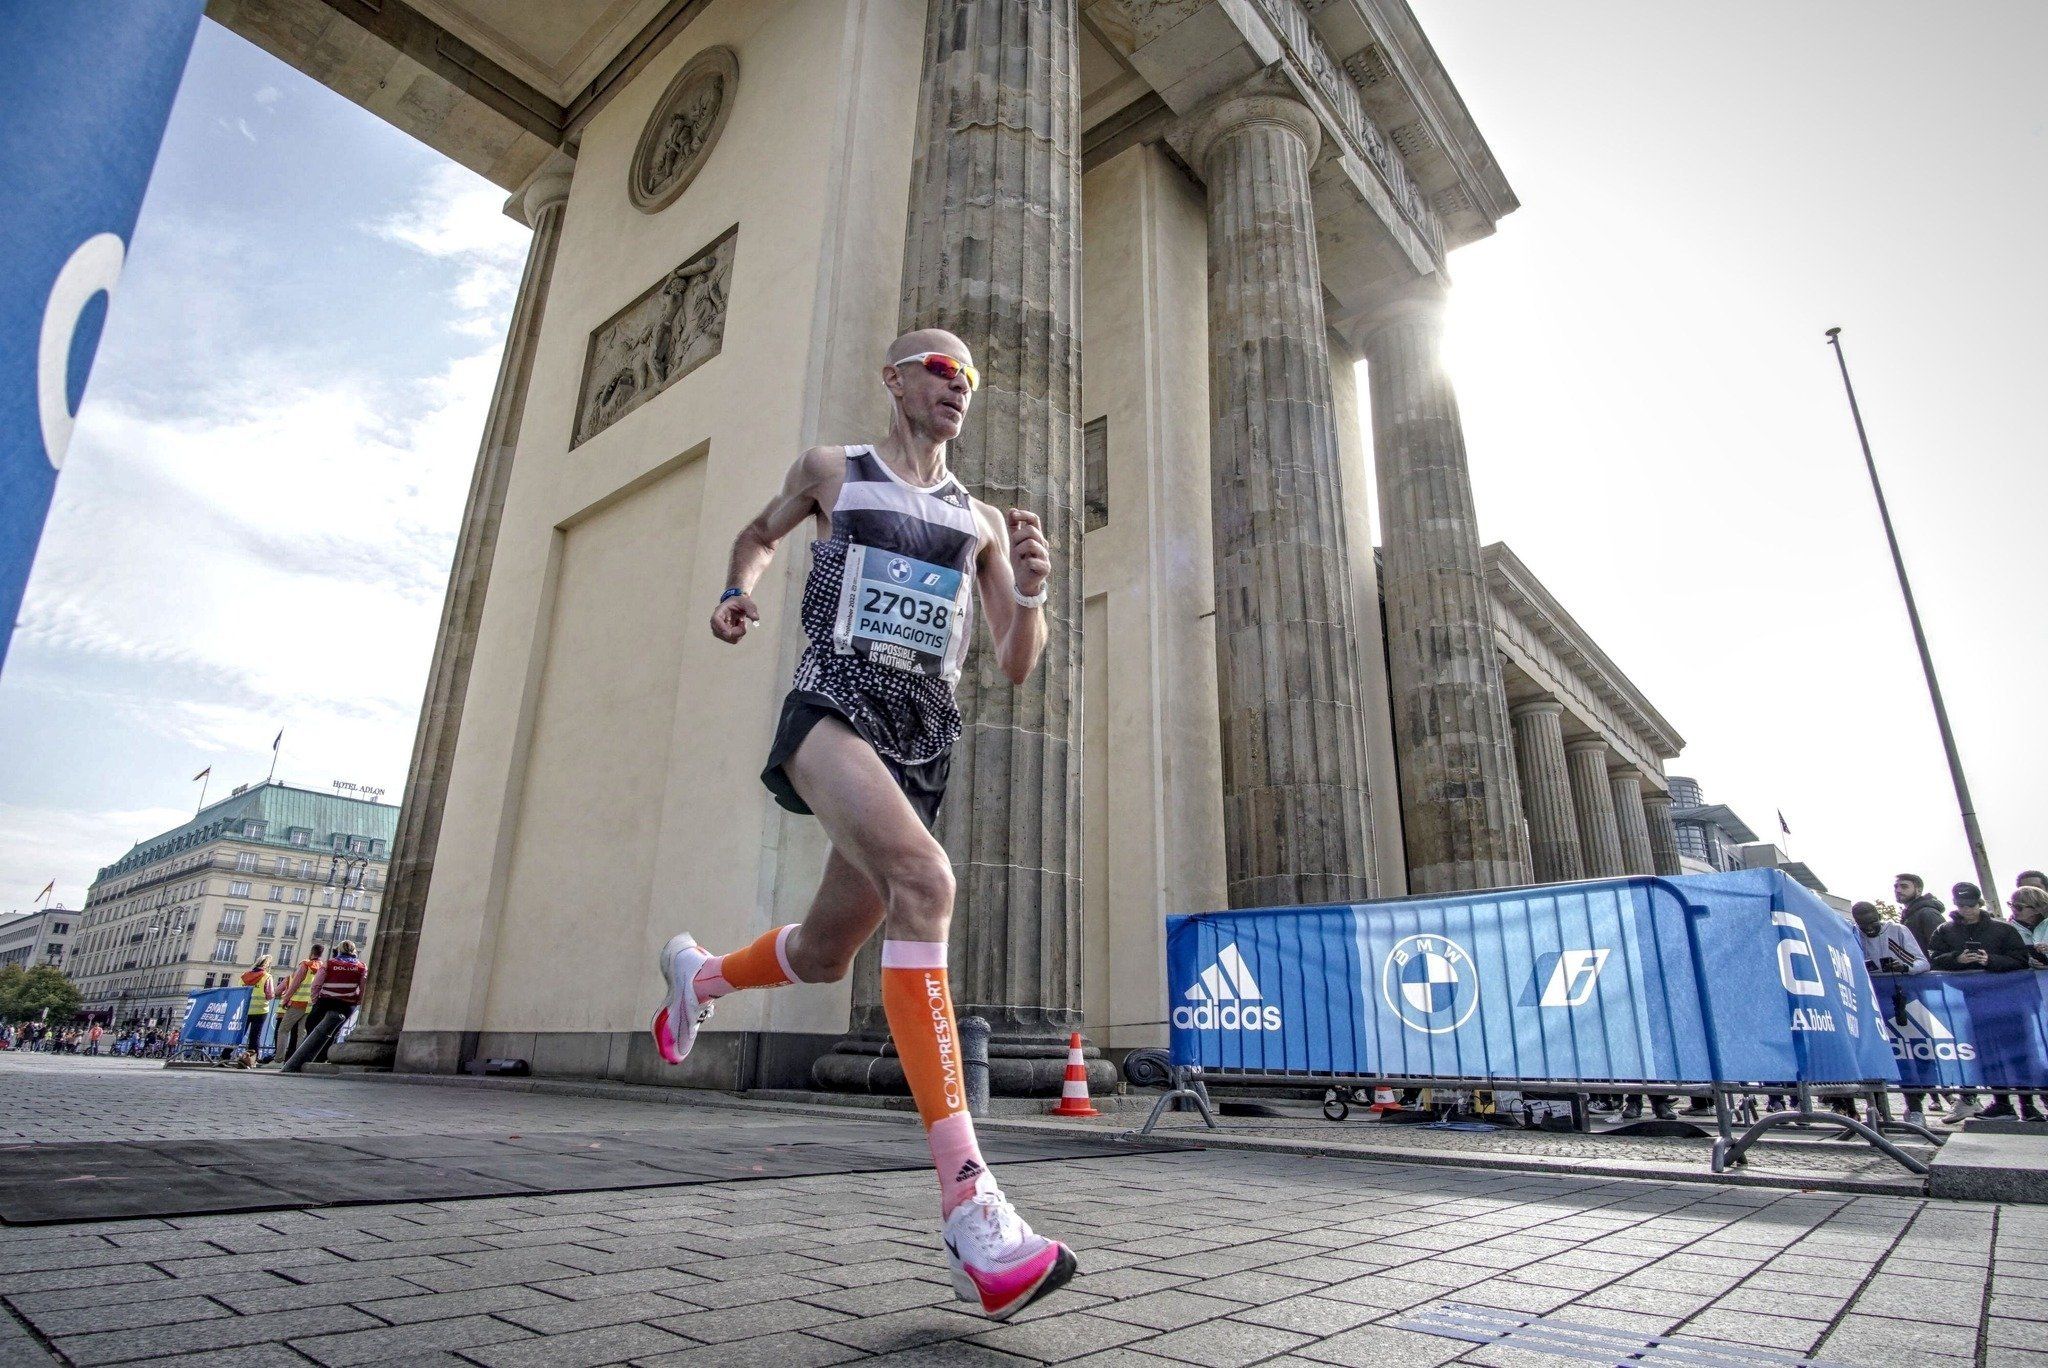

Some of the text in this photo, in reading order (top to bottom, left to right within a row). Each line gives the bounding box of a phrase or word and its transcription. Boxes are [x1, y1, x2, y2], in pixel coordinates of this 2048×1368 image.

[848, 593, 856, 608] 2022
[864, 588, 948, 629] 27038
[843, 608, 854, 637] September
[957, 608, 964, 617] A
[860, 618, 943, 648] PANAGIOTIS
[868, 651, 912, 671] IS NOTHING
[870, 641, 916, 661] IMPOSSIBLE
[333, 780, 385, 795] HOTEL ADLON
[1173, 999, 1282, 1030] adidas
[1790, 1008, 1836, 1032] Abbott
[1890, 1037, 1976, 1060] didas
